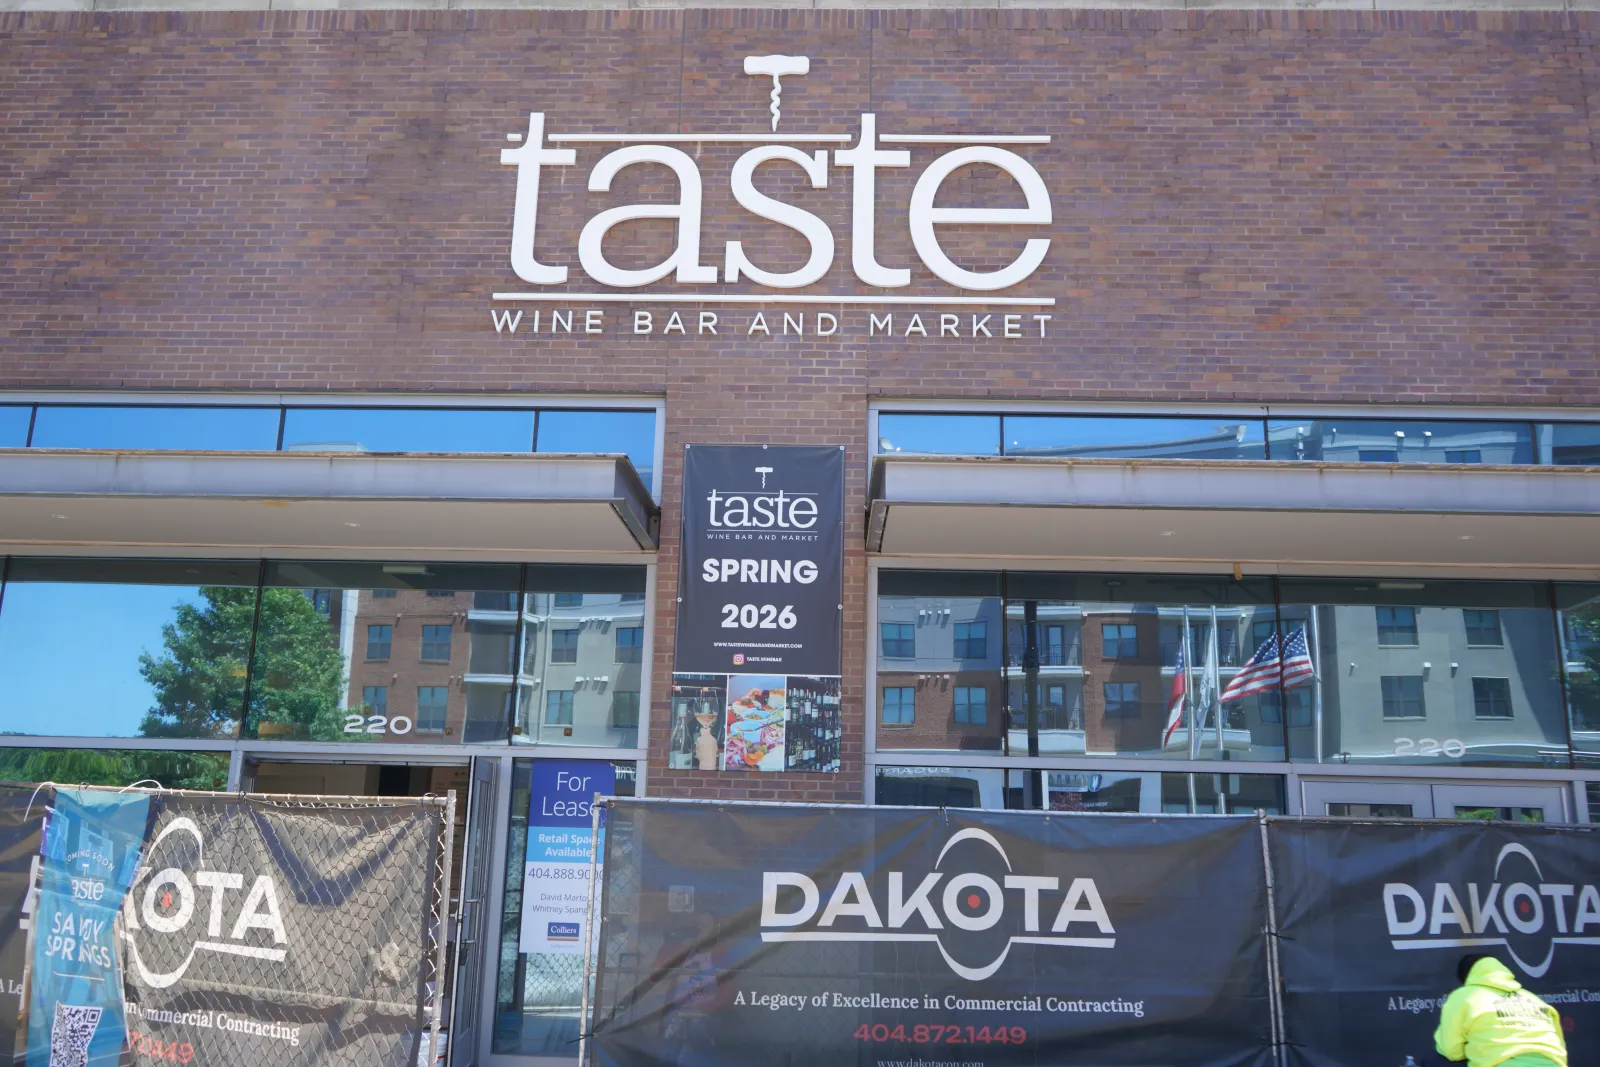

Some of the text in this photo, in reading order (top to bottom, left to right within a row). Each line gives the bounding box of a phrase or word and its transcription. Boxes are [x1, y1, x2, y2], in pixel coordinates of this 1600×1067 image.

[500, 112, 1052, 290] taste
[491, 309, 1052, 338] WINE BAR AND MARKET
[707, 489, 818, 528] taste
[702, 558, 819, 584] SPRING
[721, 603, 798, 629] 2026
[343, 715, 413, 735] 220
[1393, 738, 1467, 758] 220
[556, 771, 592, 792] For
[538, 833, 568, 844] Retail
[71, 877, 105, 900] aste
[540, 893, 563, 902] David
[532, 904, 563, 915] Whitney
[760, 871, 1116, 934] DAKOTA
[550, 925, 577, 935] Colliers
[734, 991, 1145, 1018] A Legacy of Excellence in Commercial Contracting
[1388, 996, 1398, 1011] A
[1398, 996, 1436, 1014] Legacy
[216, 1012, 301, 1046] Contracting
[854, 1023, 1027, 1045] 404.872.1449
[877, 1058, 985, 1067] www.dakotacon.com
